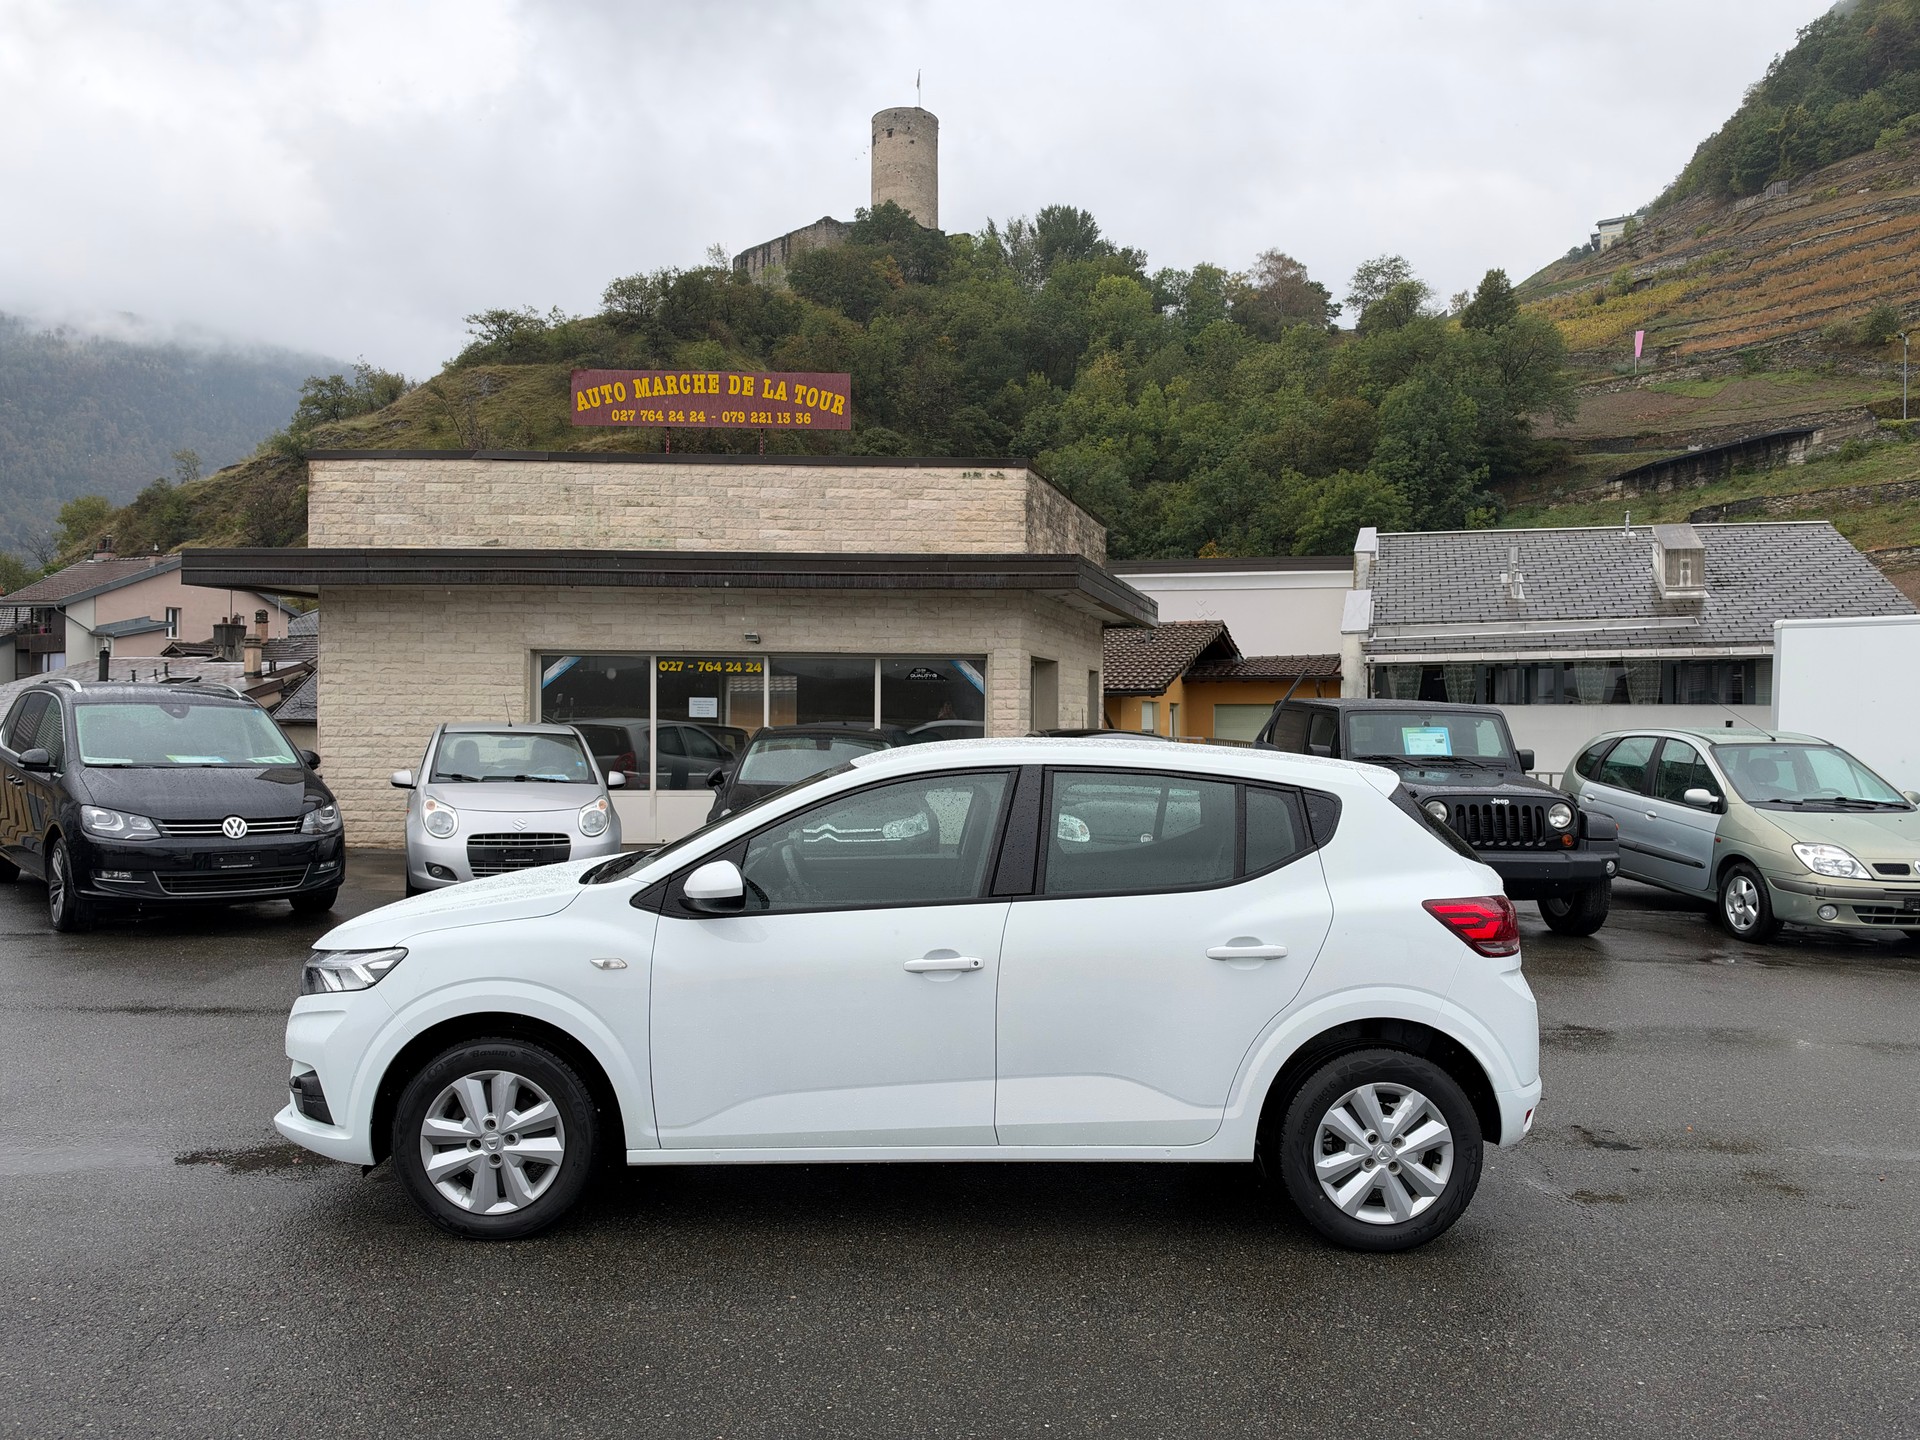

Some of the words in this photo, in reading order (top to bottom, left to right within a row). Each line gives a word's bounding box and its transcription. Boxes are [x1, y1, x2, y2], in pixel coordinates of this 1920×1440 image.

[576, 381, 627, 412] AUTO
[632, 373, 720, 399] MARCHE
[727, 374, 755, 397] DE
[762, 378, 788, 402] LA
[794, 383, 846, 416] TOUR
[611, 409, 636, 422] 027
[640, 409, 664, 423] 764
[668, 410, 685, 423] 24
[689, 410, 706, 423] 24
[722, 411, 746, 424] 079
[750, 411, 772, 424] 221
[776, 412, 791, 425] 13
[795, 412, 812, 425] 36
[658, 661, 684, 672] 027
[697, 661, 722, 672] 764
[725, 662, 742, 673] 24
[745, 662, 762, 673] 24
[1491, 797, 1510, 805] Jeep
